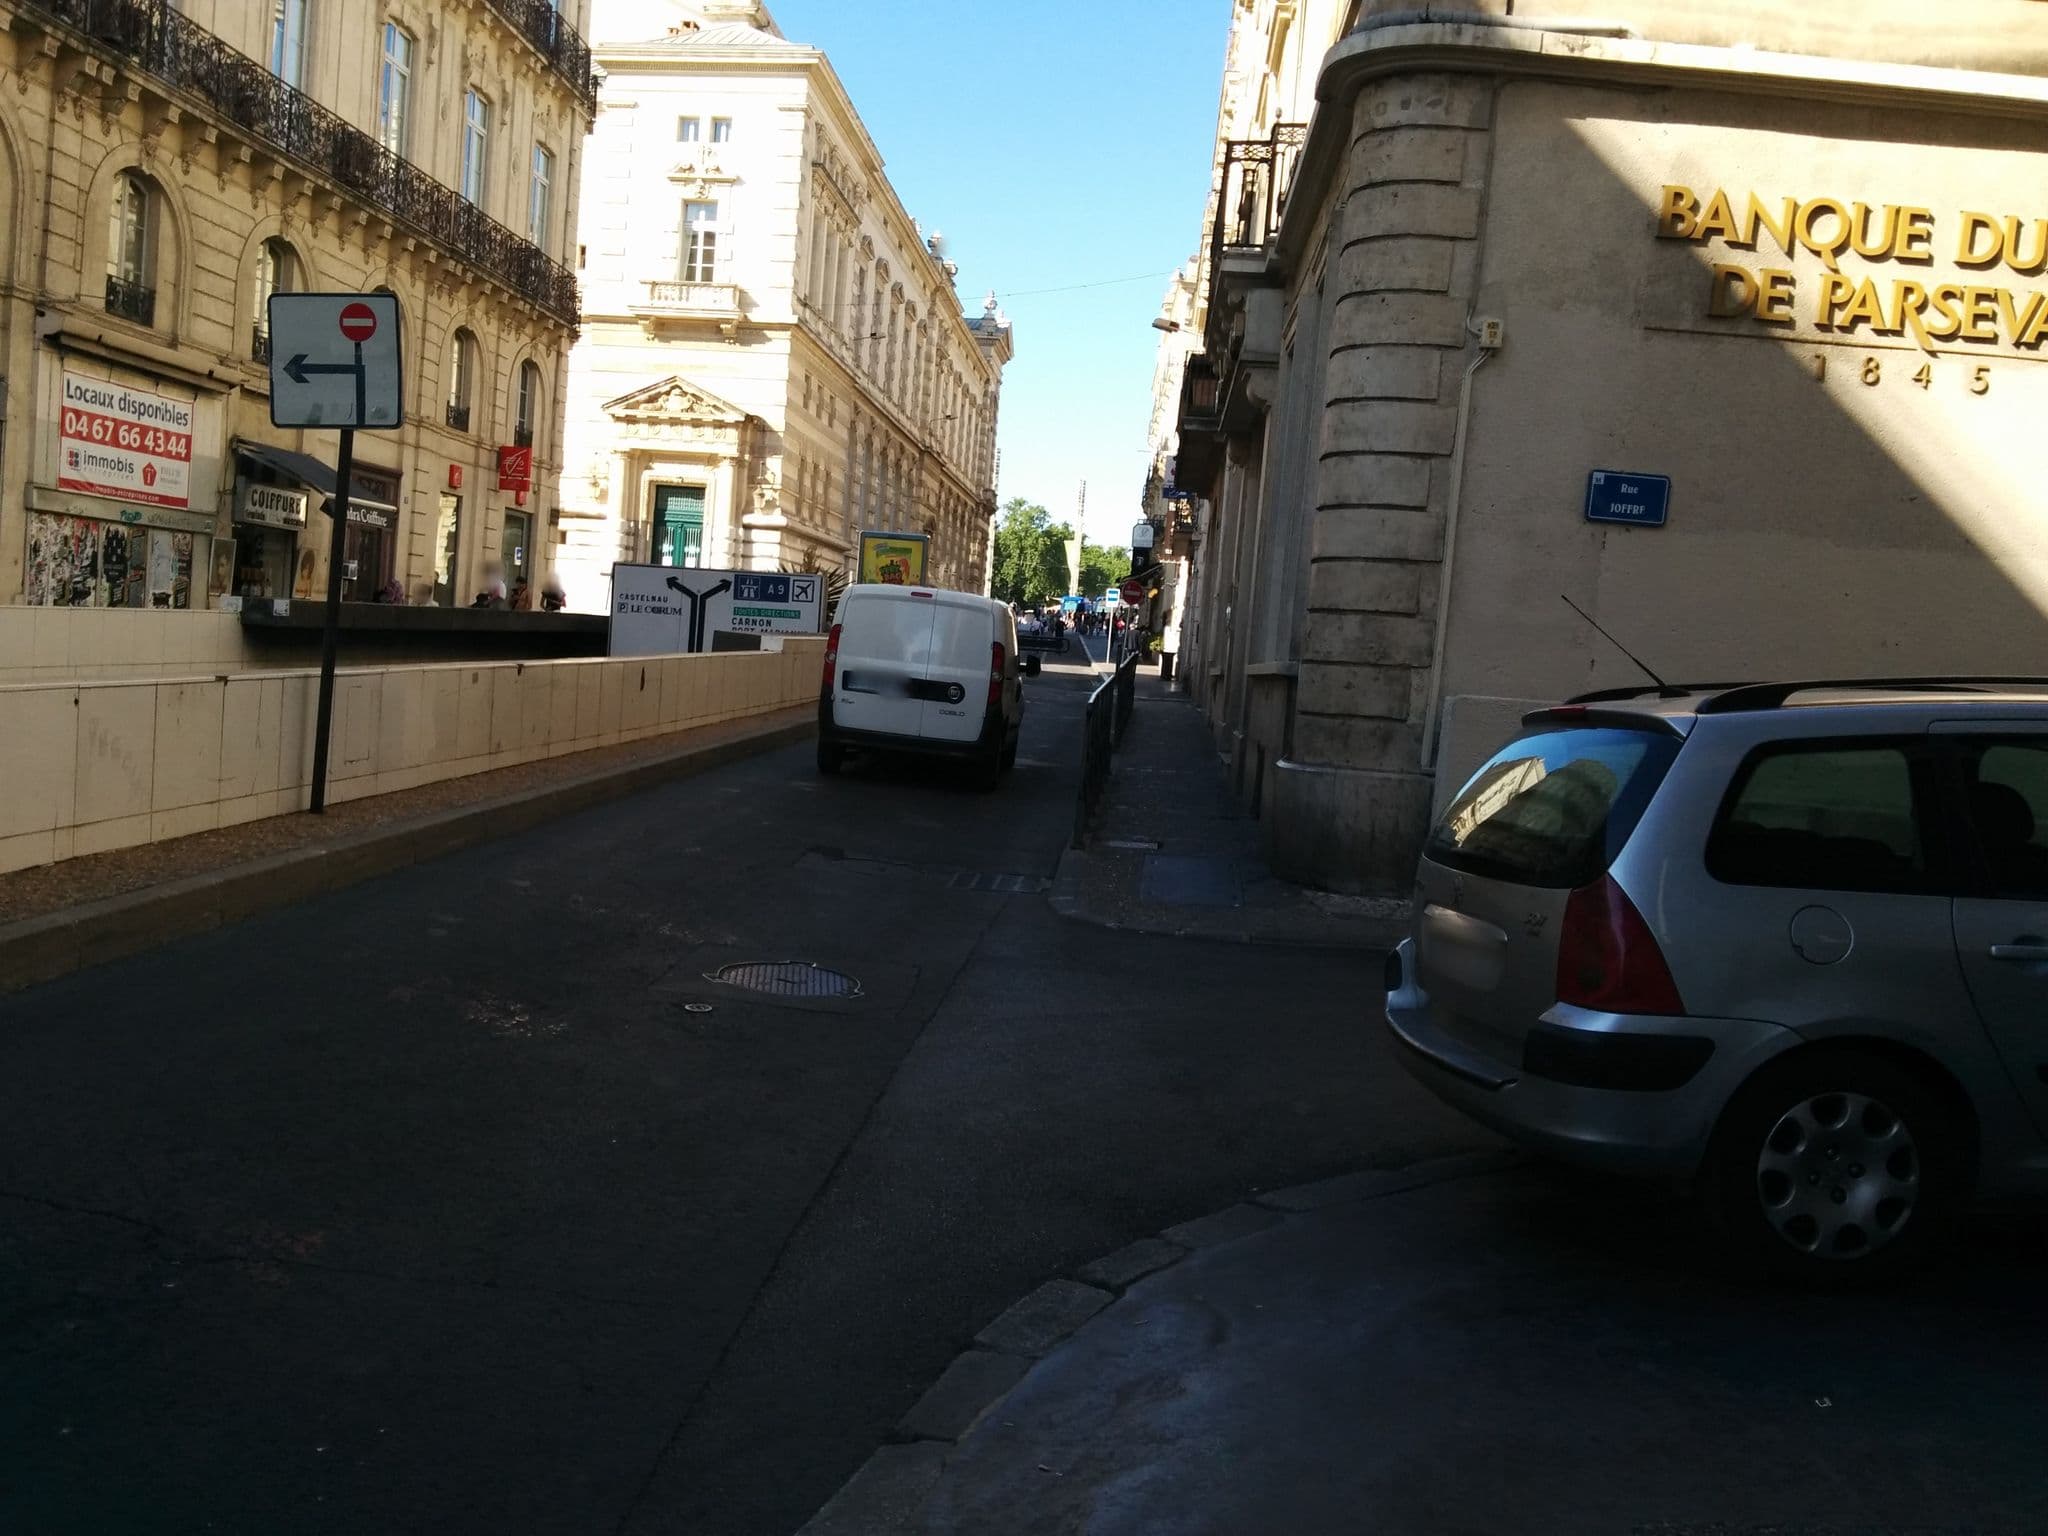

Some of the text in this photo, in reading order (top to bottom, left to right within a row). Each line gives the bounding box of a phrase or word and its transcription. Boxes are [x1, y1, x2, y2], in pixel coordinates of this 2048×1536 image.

[1656, 184, 1931, 273] BANQUE
[1708, 262, 1793, 322] DE
[66, 378, 189, 427] Locaux disponibles
[65, 412, 187, 458] 04 67 66 43 44
[83, 450, 135, 475] immobis
[1621, 483, 1639, 494] Rue
[251, 489, 301, 515] COIFFURE
[360, 508, 388, 528] Coiffure
[619, 593, 669, 603] CASTELNAU
[631, 604, 643, 614] LE
[731, 617, 772, 627] CARNON
